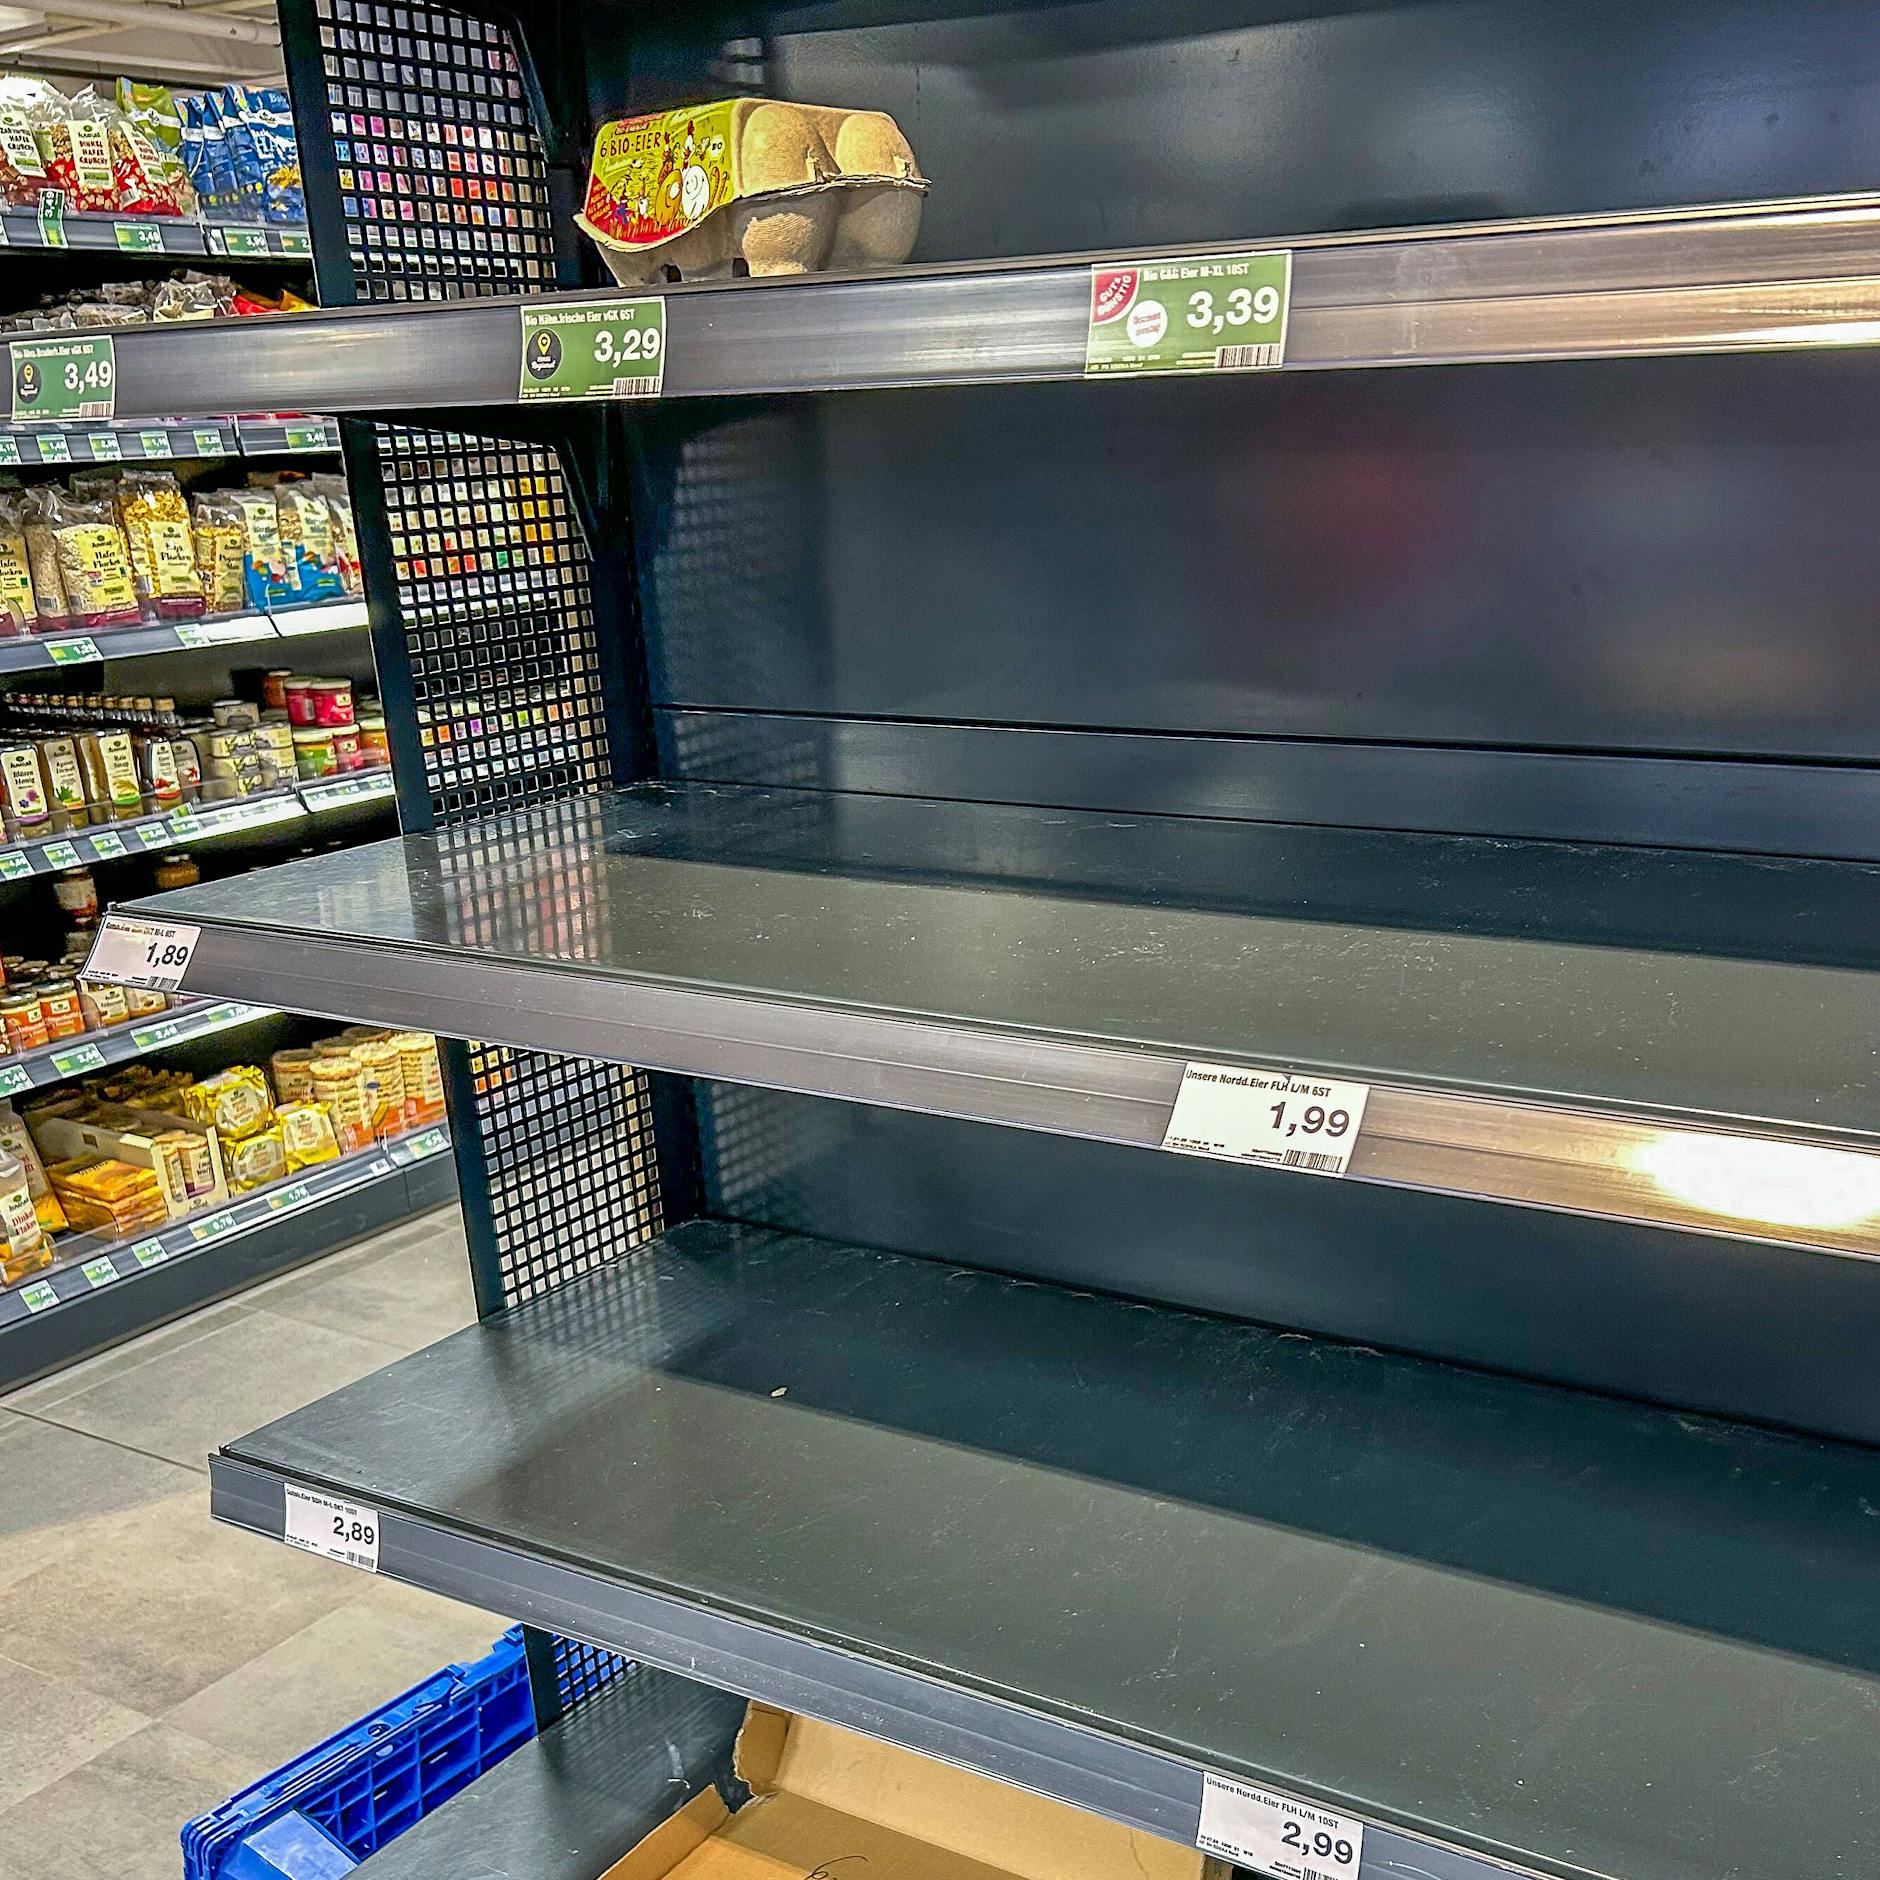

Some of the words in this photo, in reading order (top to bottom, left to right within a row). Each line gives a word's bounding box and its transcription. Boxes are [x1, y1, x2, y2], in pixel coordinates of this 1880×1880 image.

[600, 140, 608, 158] 6
[1186, 285, 1280, 336] 3,39
[593, 327, 661, 369] 3,29
[64, 360, 112, 395] 3,49
[146, 941, 189, 968] 1,89
[1185, 1069, 1218, 1083] Unsere
[1219, 1073, 1269, 1090] Nordd.Eier
[1290, 1082, 1310, 1095] L/M
[1311, 1085, 1332, 1098] 6ST
[1269, 1100, 1350, 1138] 1,99
[332, 1515, 375, 1546] 2,89
[1206, 1776, 1235, 1794] Unsere
[1236, 1786, 1281, 1809] Nordd.Eier
[1281, 1802, 1298, 1815] FLH
[1298, 1807, 1316, 1822] L/M
[1317, 1813, 1340, 1830] 10ST
[1281, 1820, 1354, 1866] 2,99
